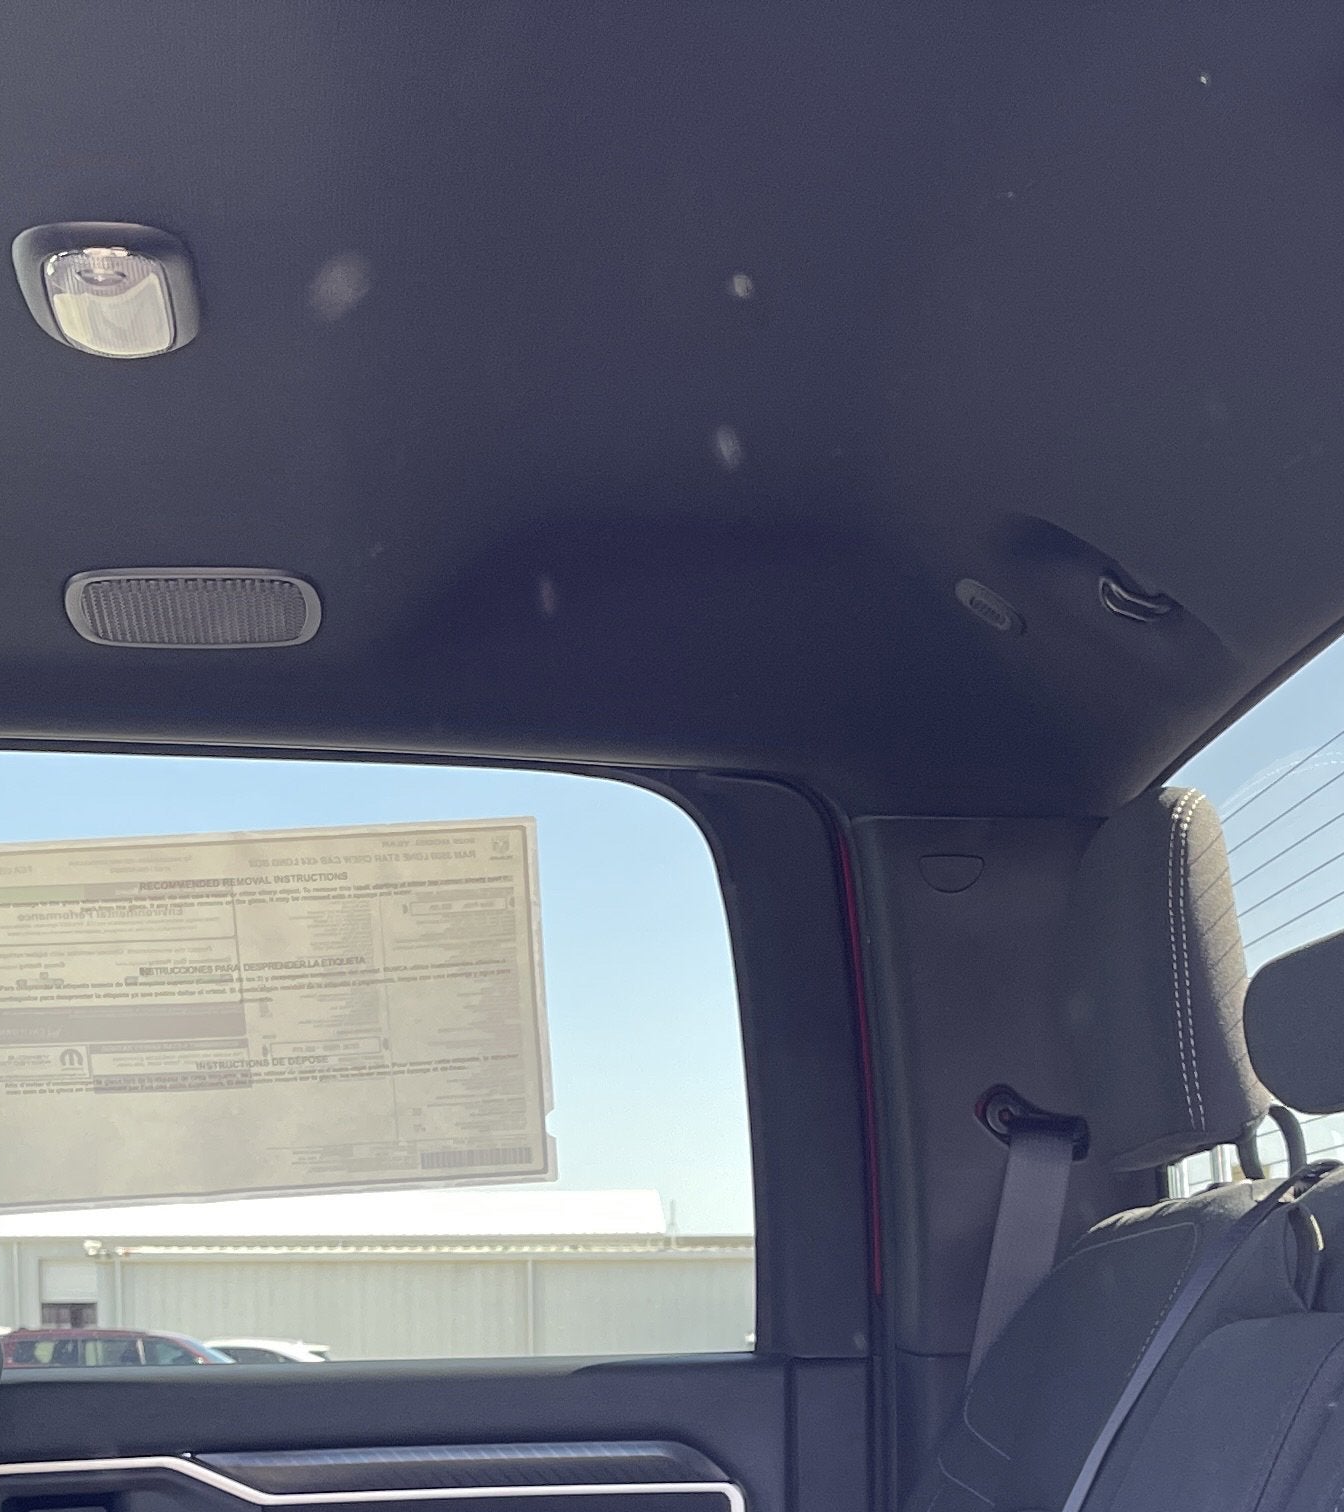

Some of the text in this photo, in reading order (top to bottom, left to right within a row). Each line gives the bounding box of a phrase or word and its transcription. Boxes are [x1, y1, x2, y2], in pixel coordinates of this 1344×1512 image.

[139, 872, 348, 891] RECOMMENDED REMOVAL INSTRUCTIONS
[214, 963, 240, 973] PARA
[243, 959, 305, 972] DESPRENDER
[307, 959, 319, 969] LA
[320, 957, 365, 968] ETIQUETA
[195, 1058, 269, 1071] INSTRUCTIONS
[271, 1057, 285, 1067] DE
